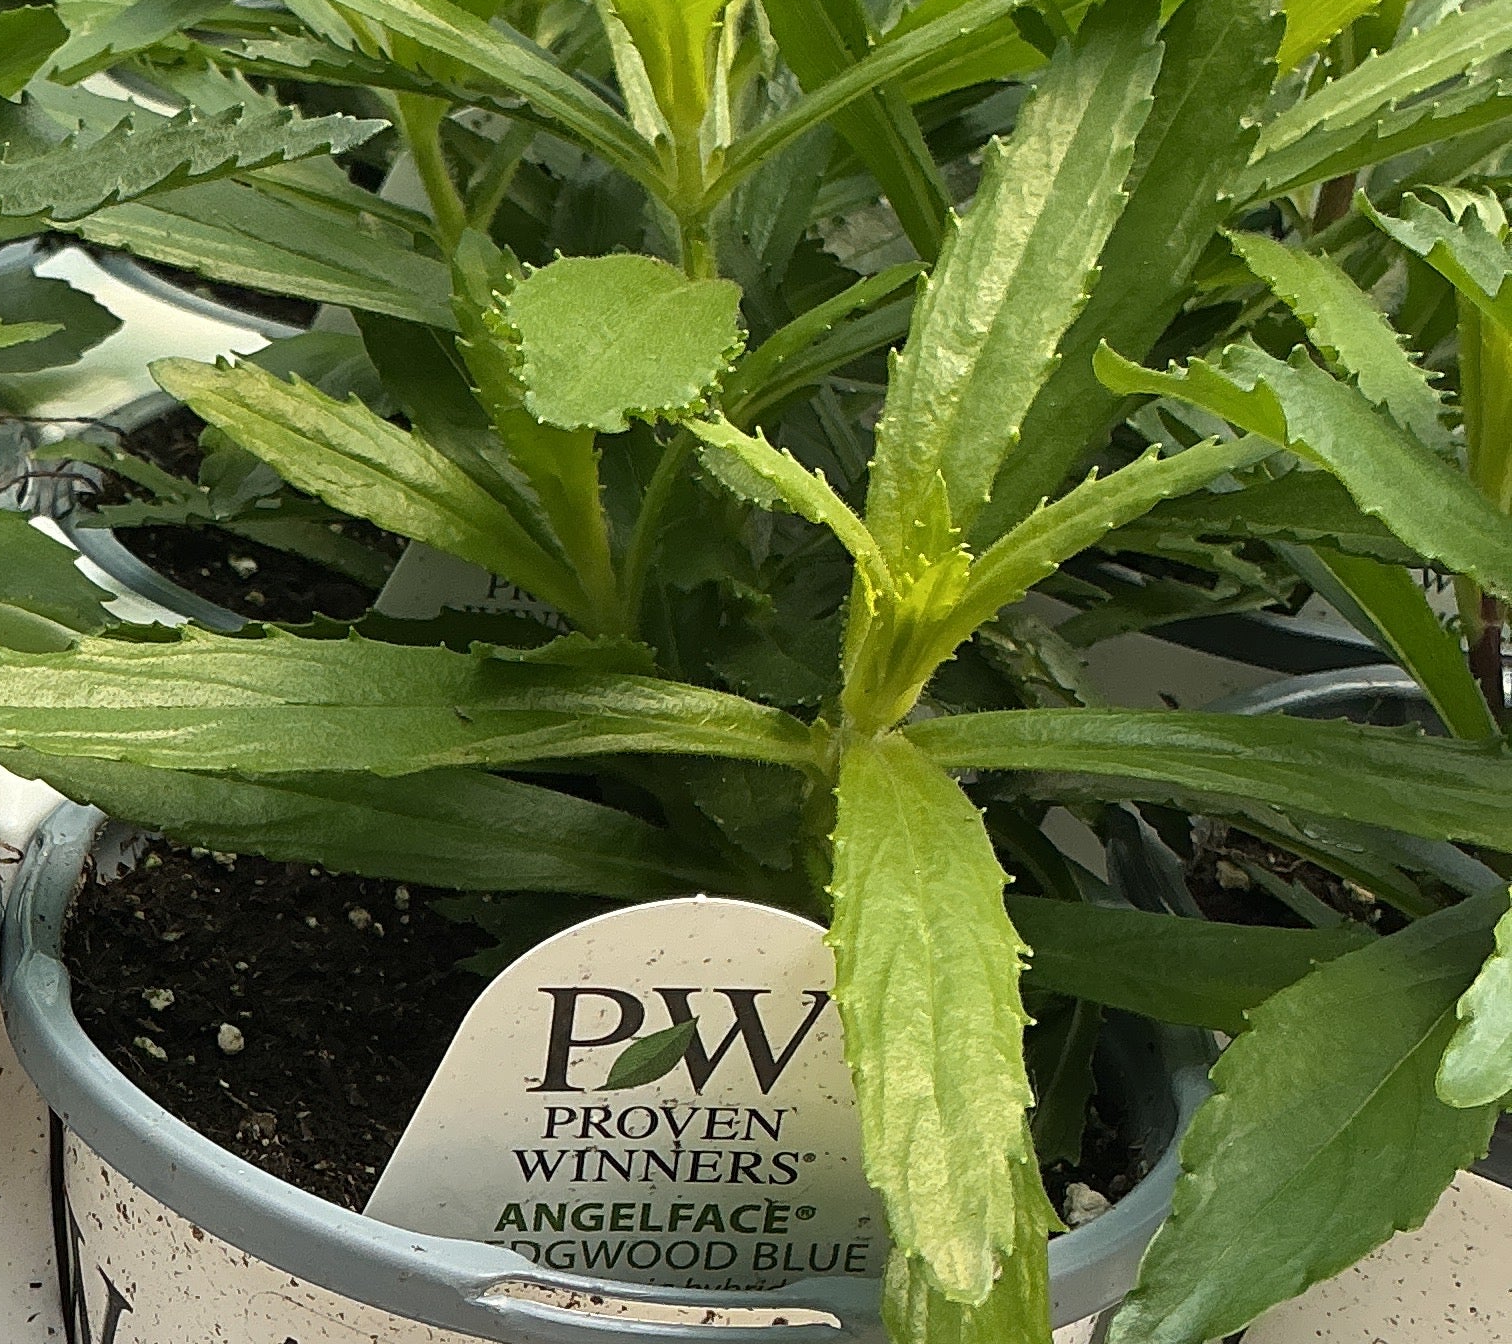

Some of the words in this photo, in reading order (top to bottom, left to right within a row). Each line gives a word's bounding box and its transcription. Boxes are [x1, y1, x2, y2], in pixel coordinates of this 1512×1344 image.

[526, 987, 833, 1096] PW
[541, 1106, 790, 1141] PROVEN
[752, 1241, 870, 1274] BLUE
